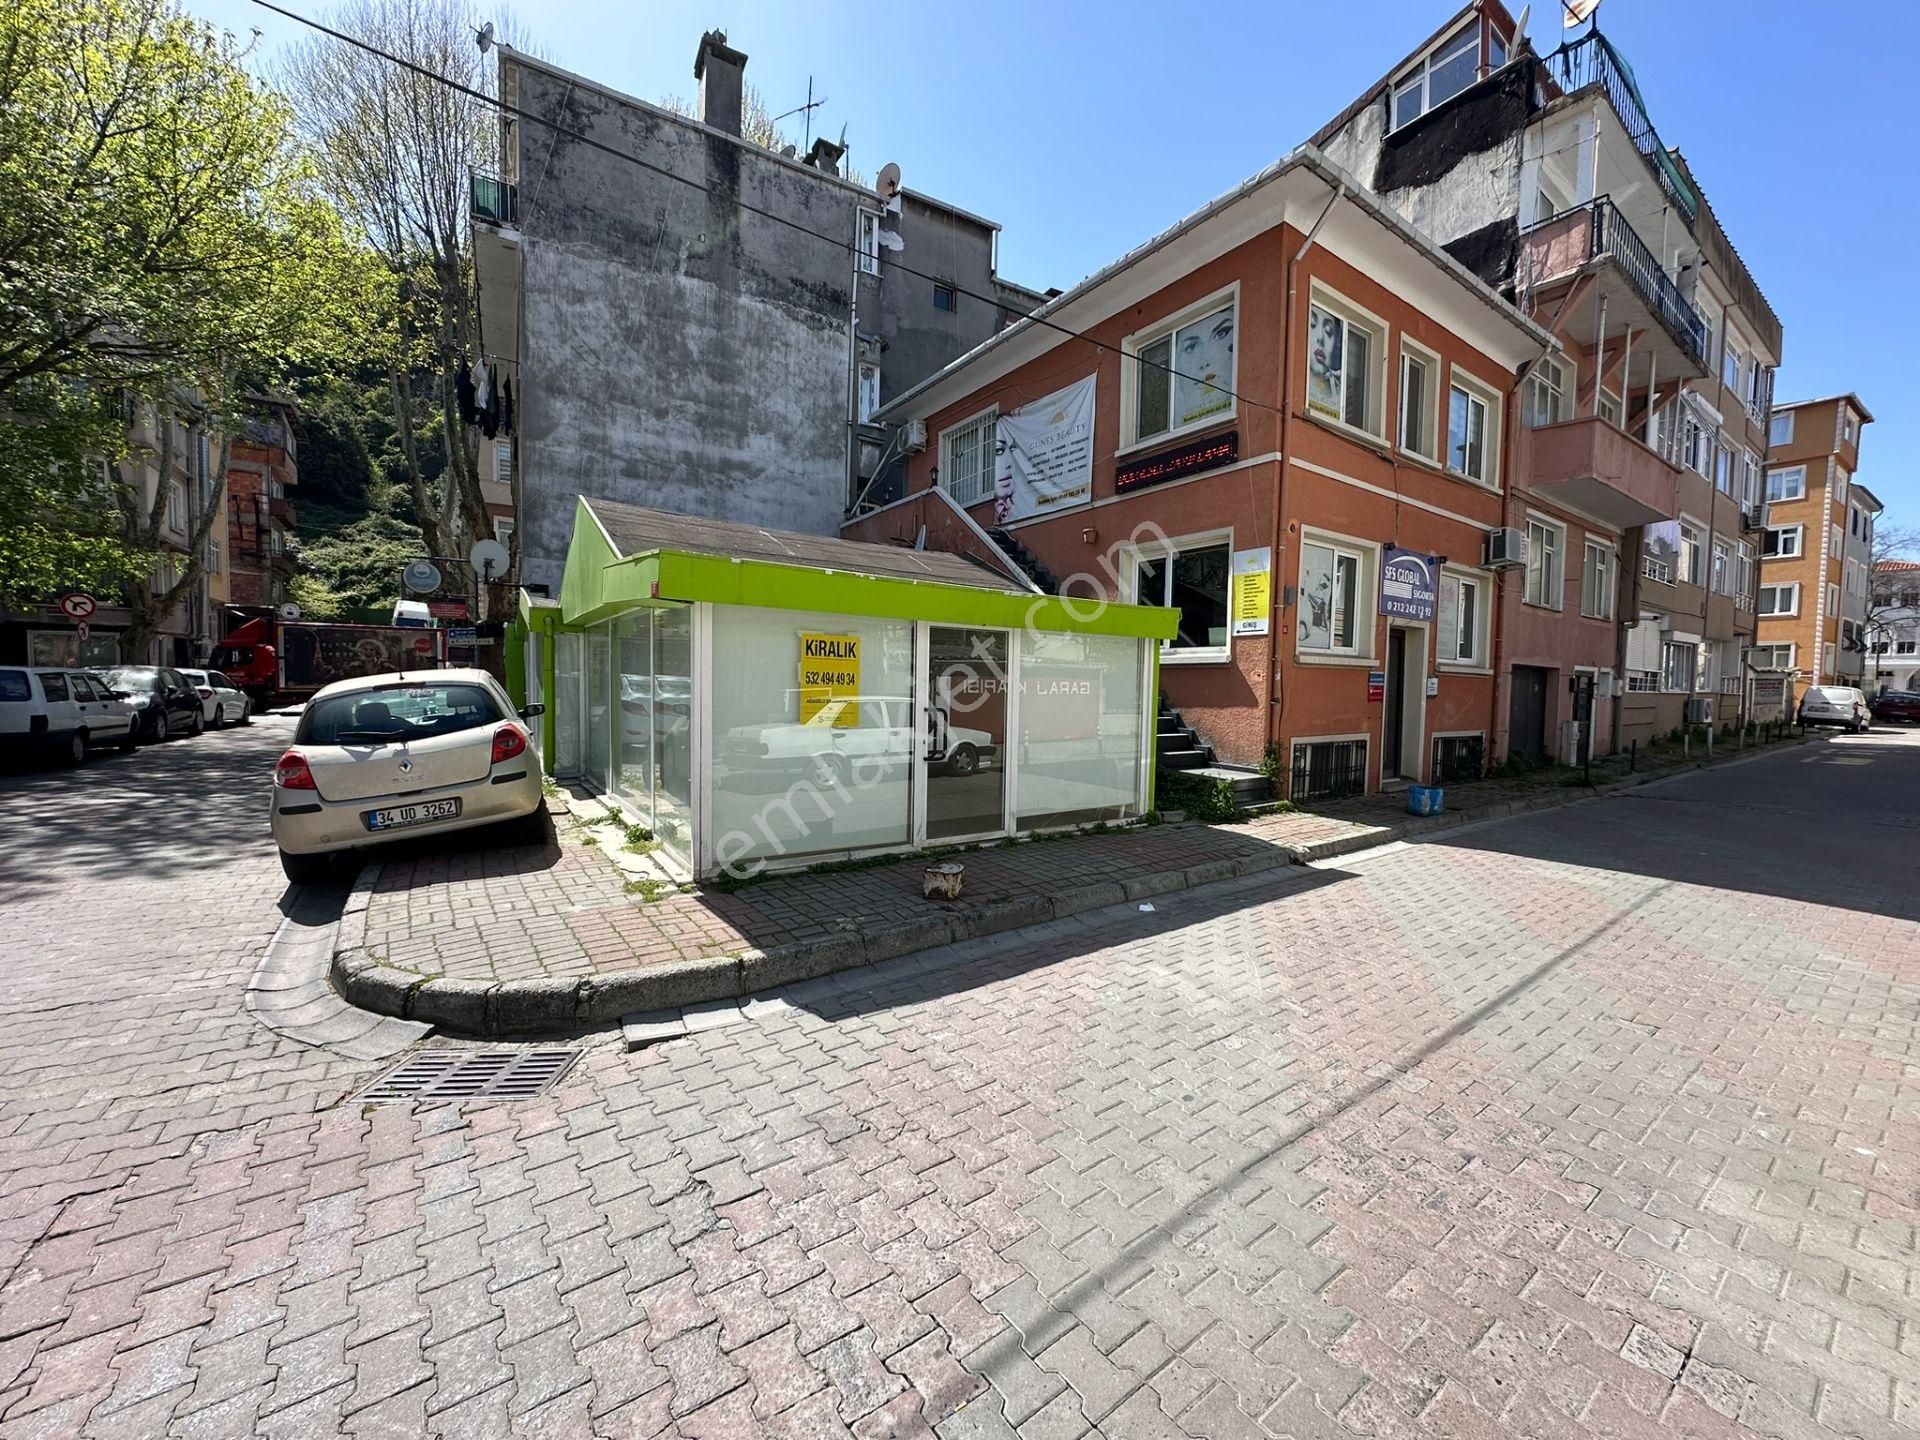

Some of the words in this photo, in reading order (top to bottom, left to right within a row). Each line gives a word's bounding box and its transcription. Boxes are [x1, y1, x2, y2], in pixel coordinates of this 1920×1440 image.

[1385, 566, 1396, 580] SFS
[1397, 568, 1420, 585] GLOBAL
[1387, 600, 1392, 610] 0
[1393, 601, 1404, 612] 212
[1405, 603, 1416, 614] 242
[806, 671, 819, 685] 532
[821, 672, 834, 685] 494
[836, 672, 845, 685] 49
[846, 673, 855, 685] 34
[378, 811, 394, 824] 34
[422, 801, 453, 817] 3262
